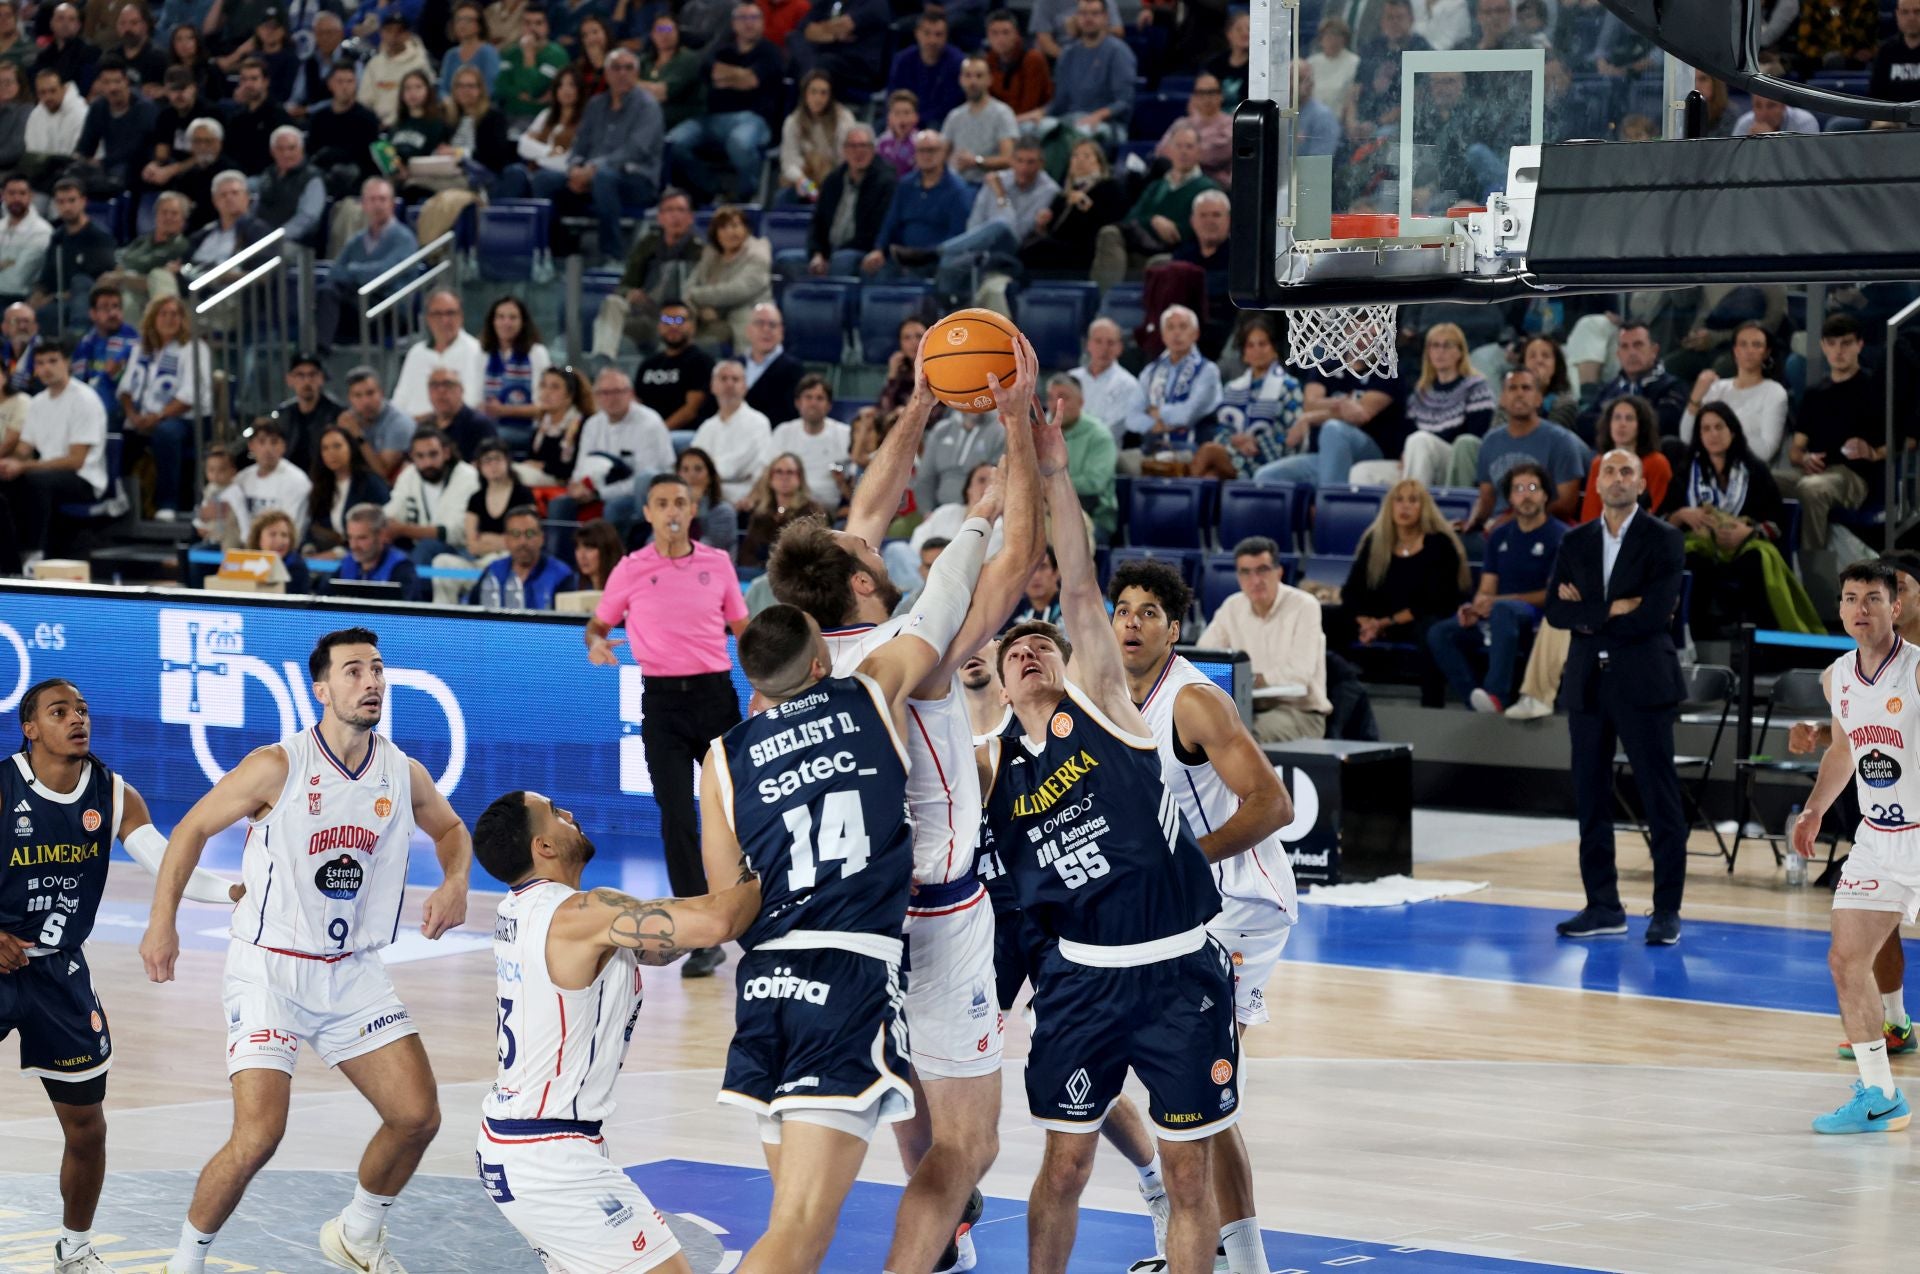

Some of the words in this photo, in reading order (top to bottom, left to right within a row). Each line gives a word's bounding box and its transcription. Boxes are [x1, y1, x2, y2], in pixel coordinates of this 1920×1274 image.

[780, 692, 829, 714] Enerthy
[750, 717, 833, 768] SHELIST
[836, 712, 861, 734] D.
[1863, 760, 1892, 769] Estrella
[1865, 769, 1893, 779] Galicia
[1010, 750, 1099, 821] ALIMERKA
[782, 790, 871, 892] 14
[1061, 815, 1107, 845] Asturias
[1065, 836, 1087, 853] paraiso
[1088, 826, 1110, 841] natural
[9, 841, 99, 867] ALIMERKA
[1053, 841, 1111, 890] 55
[325, 877, 359, 889] Galicia
[326, 866, 360, 878] Estrella
[39, 912, 67, 946] 5
[328, 917, 349, 949] 9
[1164, 1112, 1203, 1123] LIMERKA
